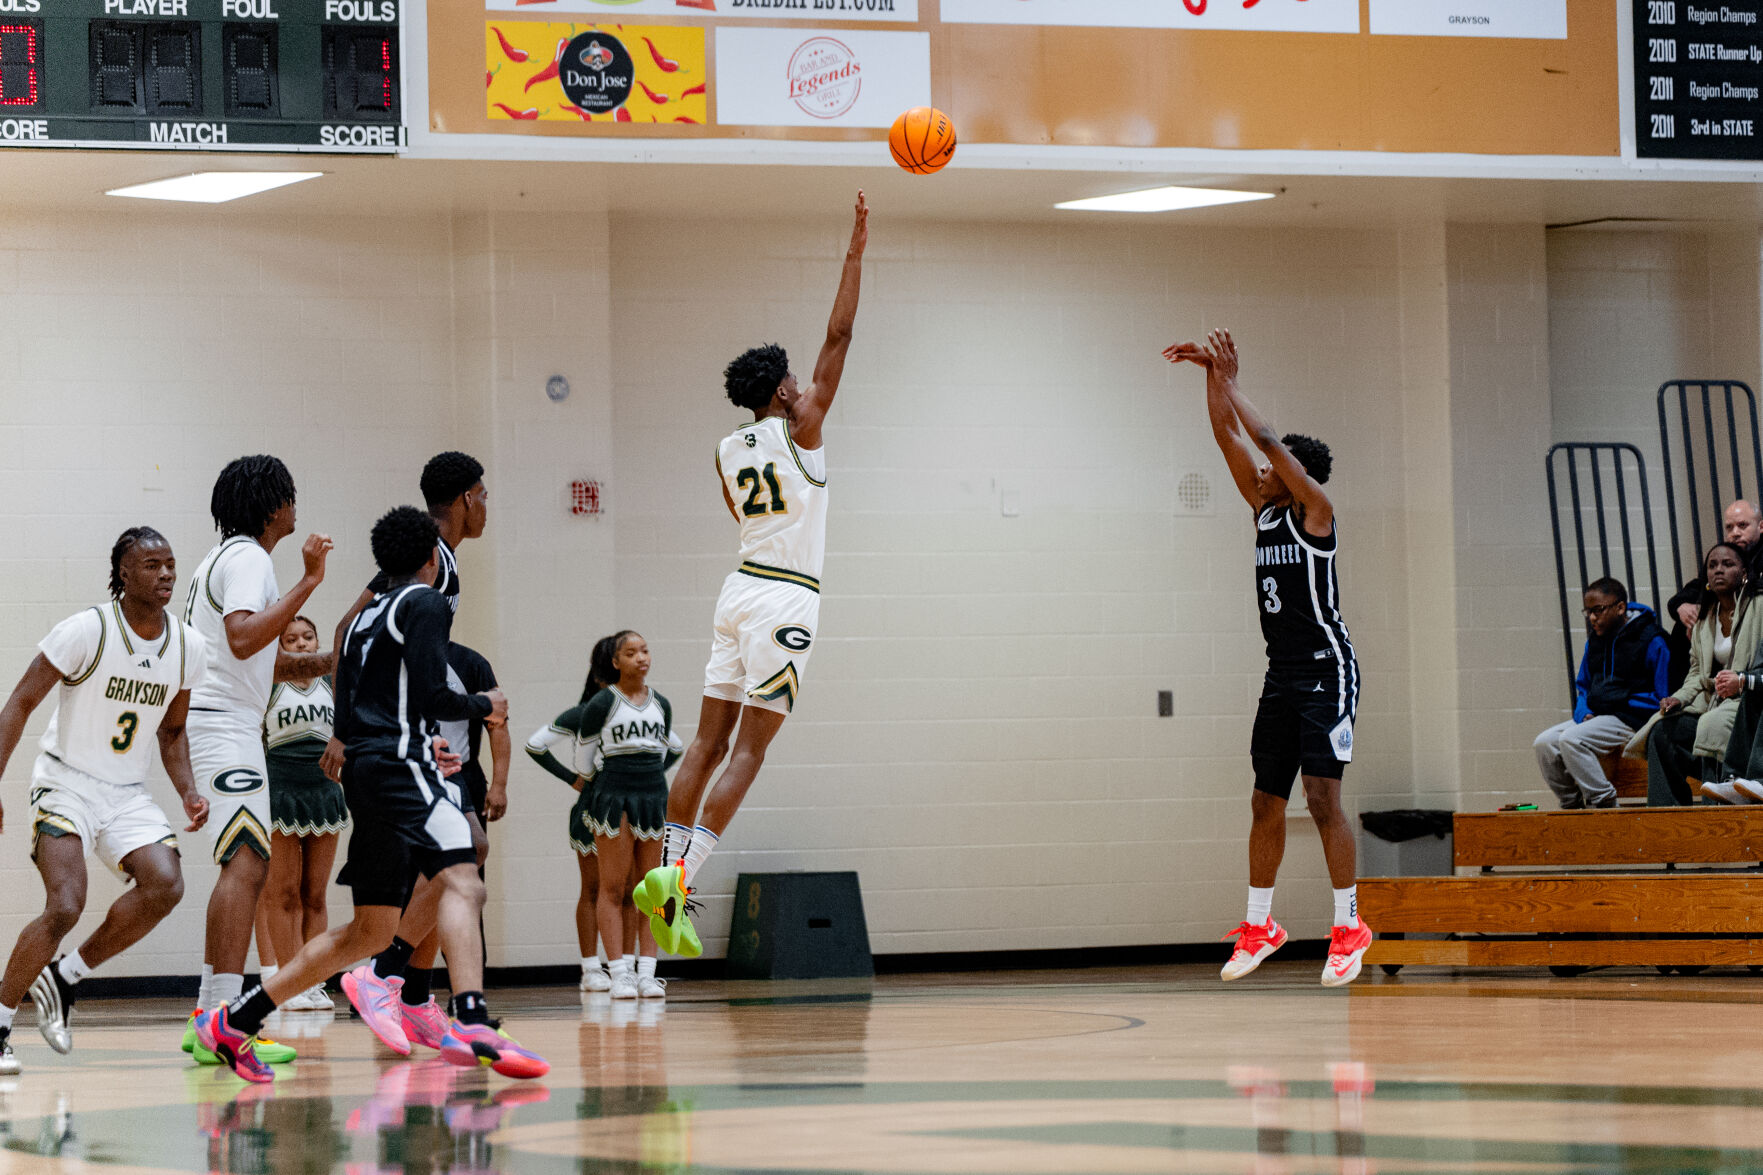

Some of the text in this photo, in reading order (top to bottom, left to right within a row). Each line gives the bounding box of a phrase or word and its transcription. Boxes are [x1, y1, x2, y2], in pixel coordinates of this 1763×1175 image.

[105, 0, 188, 16] PLAYER
[222, 0, 279, 18] FOUL
[325, 0, 396, 22] FOULS
[1448, 15, 1490, 25] GRAYSON
[1648, 1, 1757, 26] 2010 Region Champs
[1649, 38, 1762, 64] 2010 STATE Runner Up
[567, 70, 628, 91] Don Jose
[789, 60, 861, 98] Legends
[1649, 76, 1759, 101] 2011 Region Champs
[0, 119, 49, 140] ORE
[150, 122, 228, 144] MATCH
[320, 125, 396, 147] SCORE
[1651, 114, 1754, 138] 2011 3rd in STATE
[736, 462, 788, 518] 21
[1263, 576, 1281, 614] 3
[774, 626, 812, 650] G
[105, 676, 169, 707] GRAYSON
[110, 711, 140, 754] 3
[213, 768, 264, 793] G
